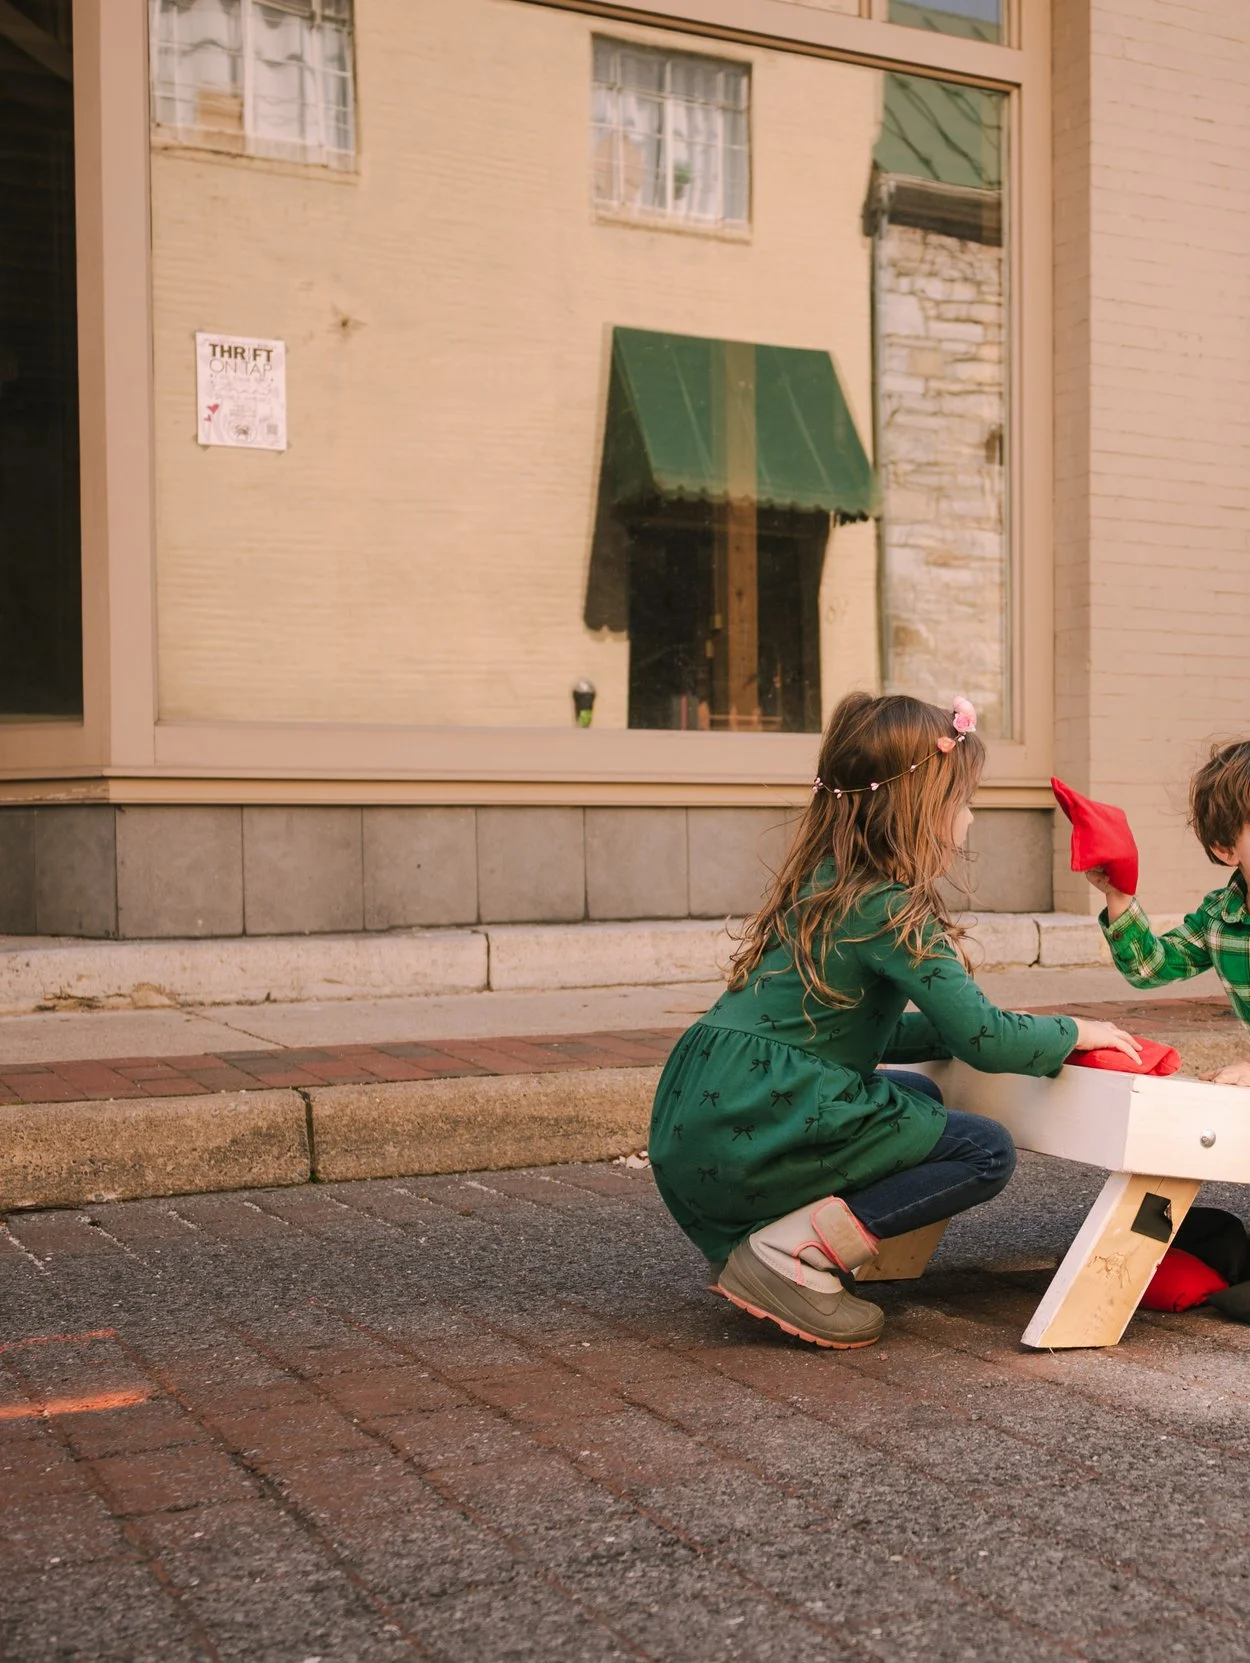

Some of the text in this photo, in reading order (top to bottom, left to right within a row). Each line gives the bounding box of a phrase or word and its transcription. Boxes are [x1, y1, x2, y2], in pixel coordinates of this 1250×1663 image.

[209, 343, 273, 362] THRIFT
[209, 358, 272, 377] ON TAP
